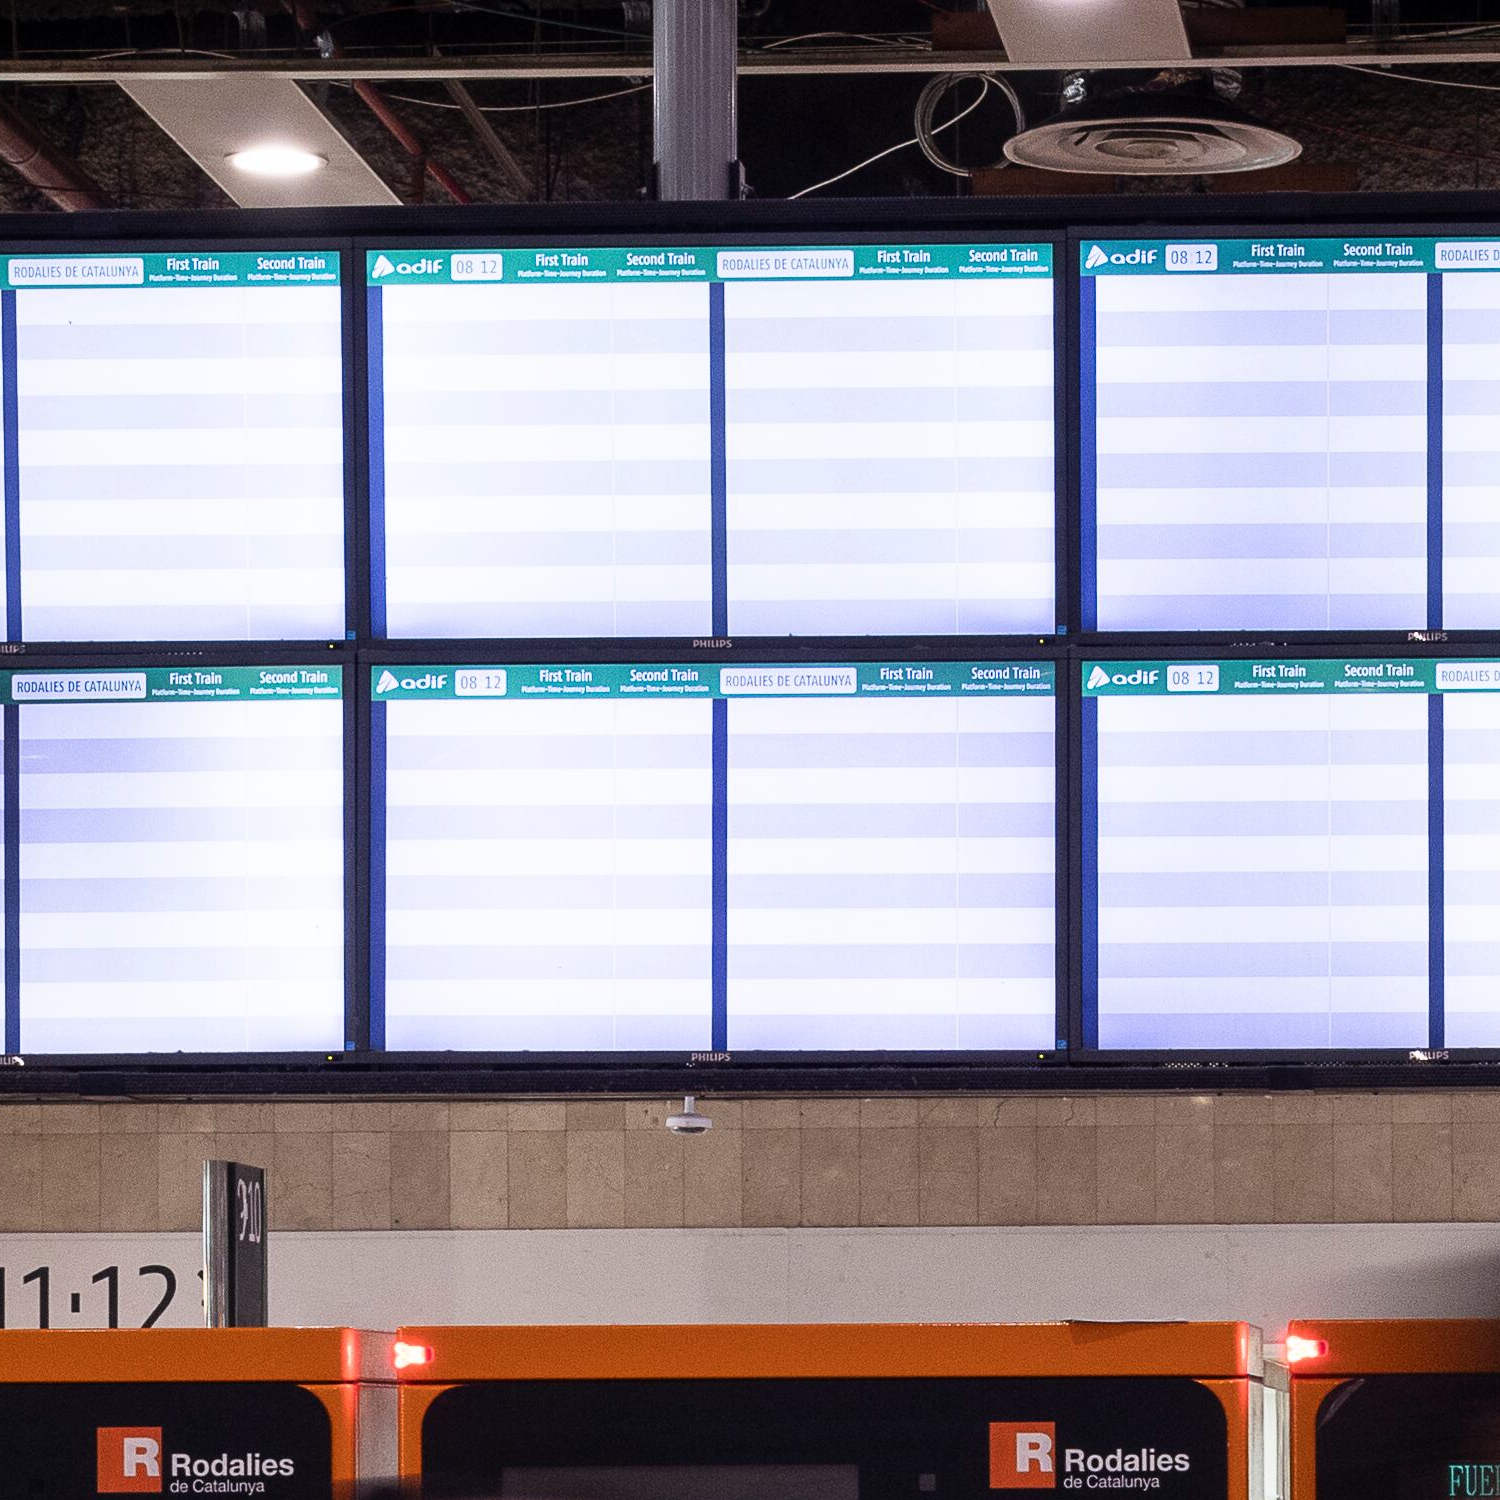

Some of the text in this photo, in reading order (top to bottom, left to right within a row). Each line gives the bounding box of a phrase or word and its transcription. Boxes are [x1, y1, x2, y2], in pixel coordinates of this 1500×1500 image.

[170, 672, 222, 685] First Train
[260, 671, 328, 684] Second Train
[17, 679, 142, 693] RODALIES DE CATALUNYA
[171, 1453, 294, 1477] Rodalies
[1065, 1449, 1189, 1473] Rodalies
[170, 1480, 264, 1496] de Catalunya
[1064, 1475, 1160, 1491] de Catalunya
